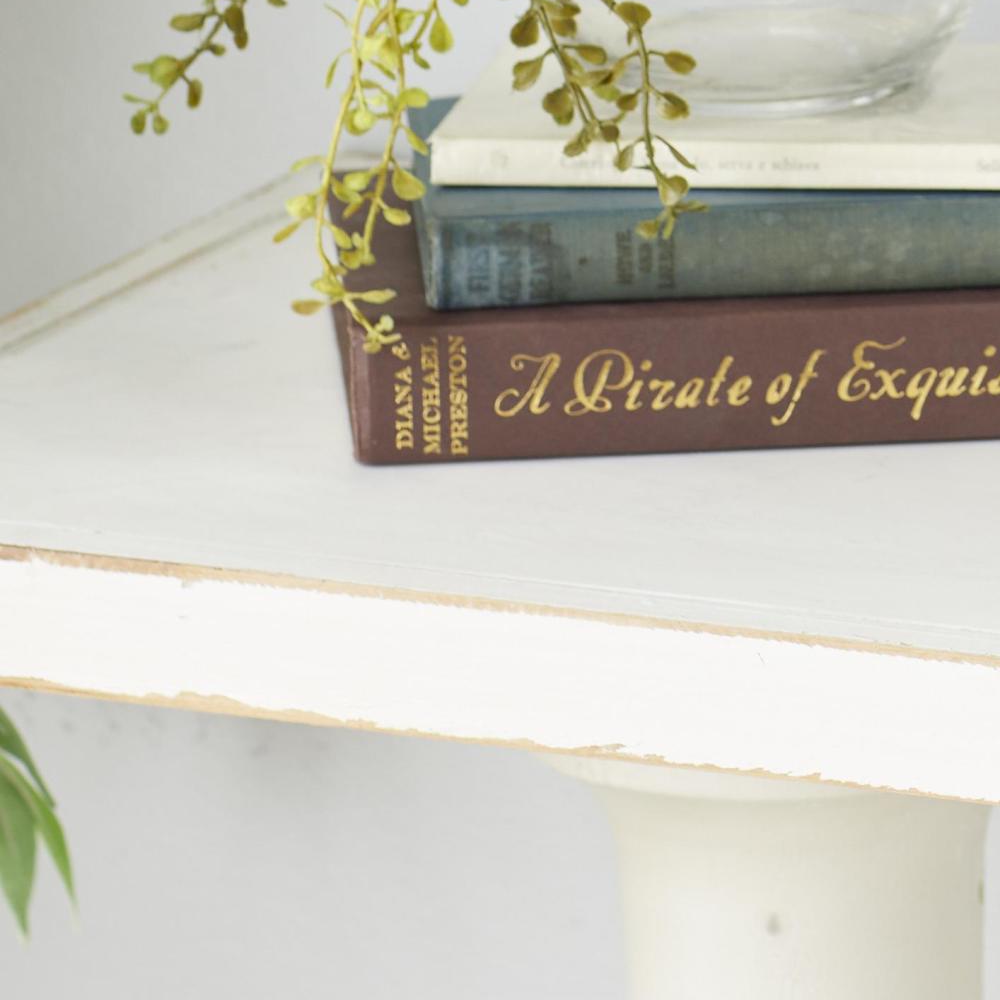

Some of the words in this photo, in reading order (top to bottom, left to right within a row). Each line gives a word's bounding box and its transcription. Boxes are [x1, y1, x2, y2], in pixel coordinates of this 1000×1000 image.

[390, 340, 411, 361] &
[494, 352, 562, 418] A
[563, 348, 752, 418] Pirate
[765, 349, 829, 427] of
[394, 365, 414, 450] DIANA
[420, 336, 442, 456] MICHAEL
[447, 334, 470, 457] PRESTON
